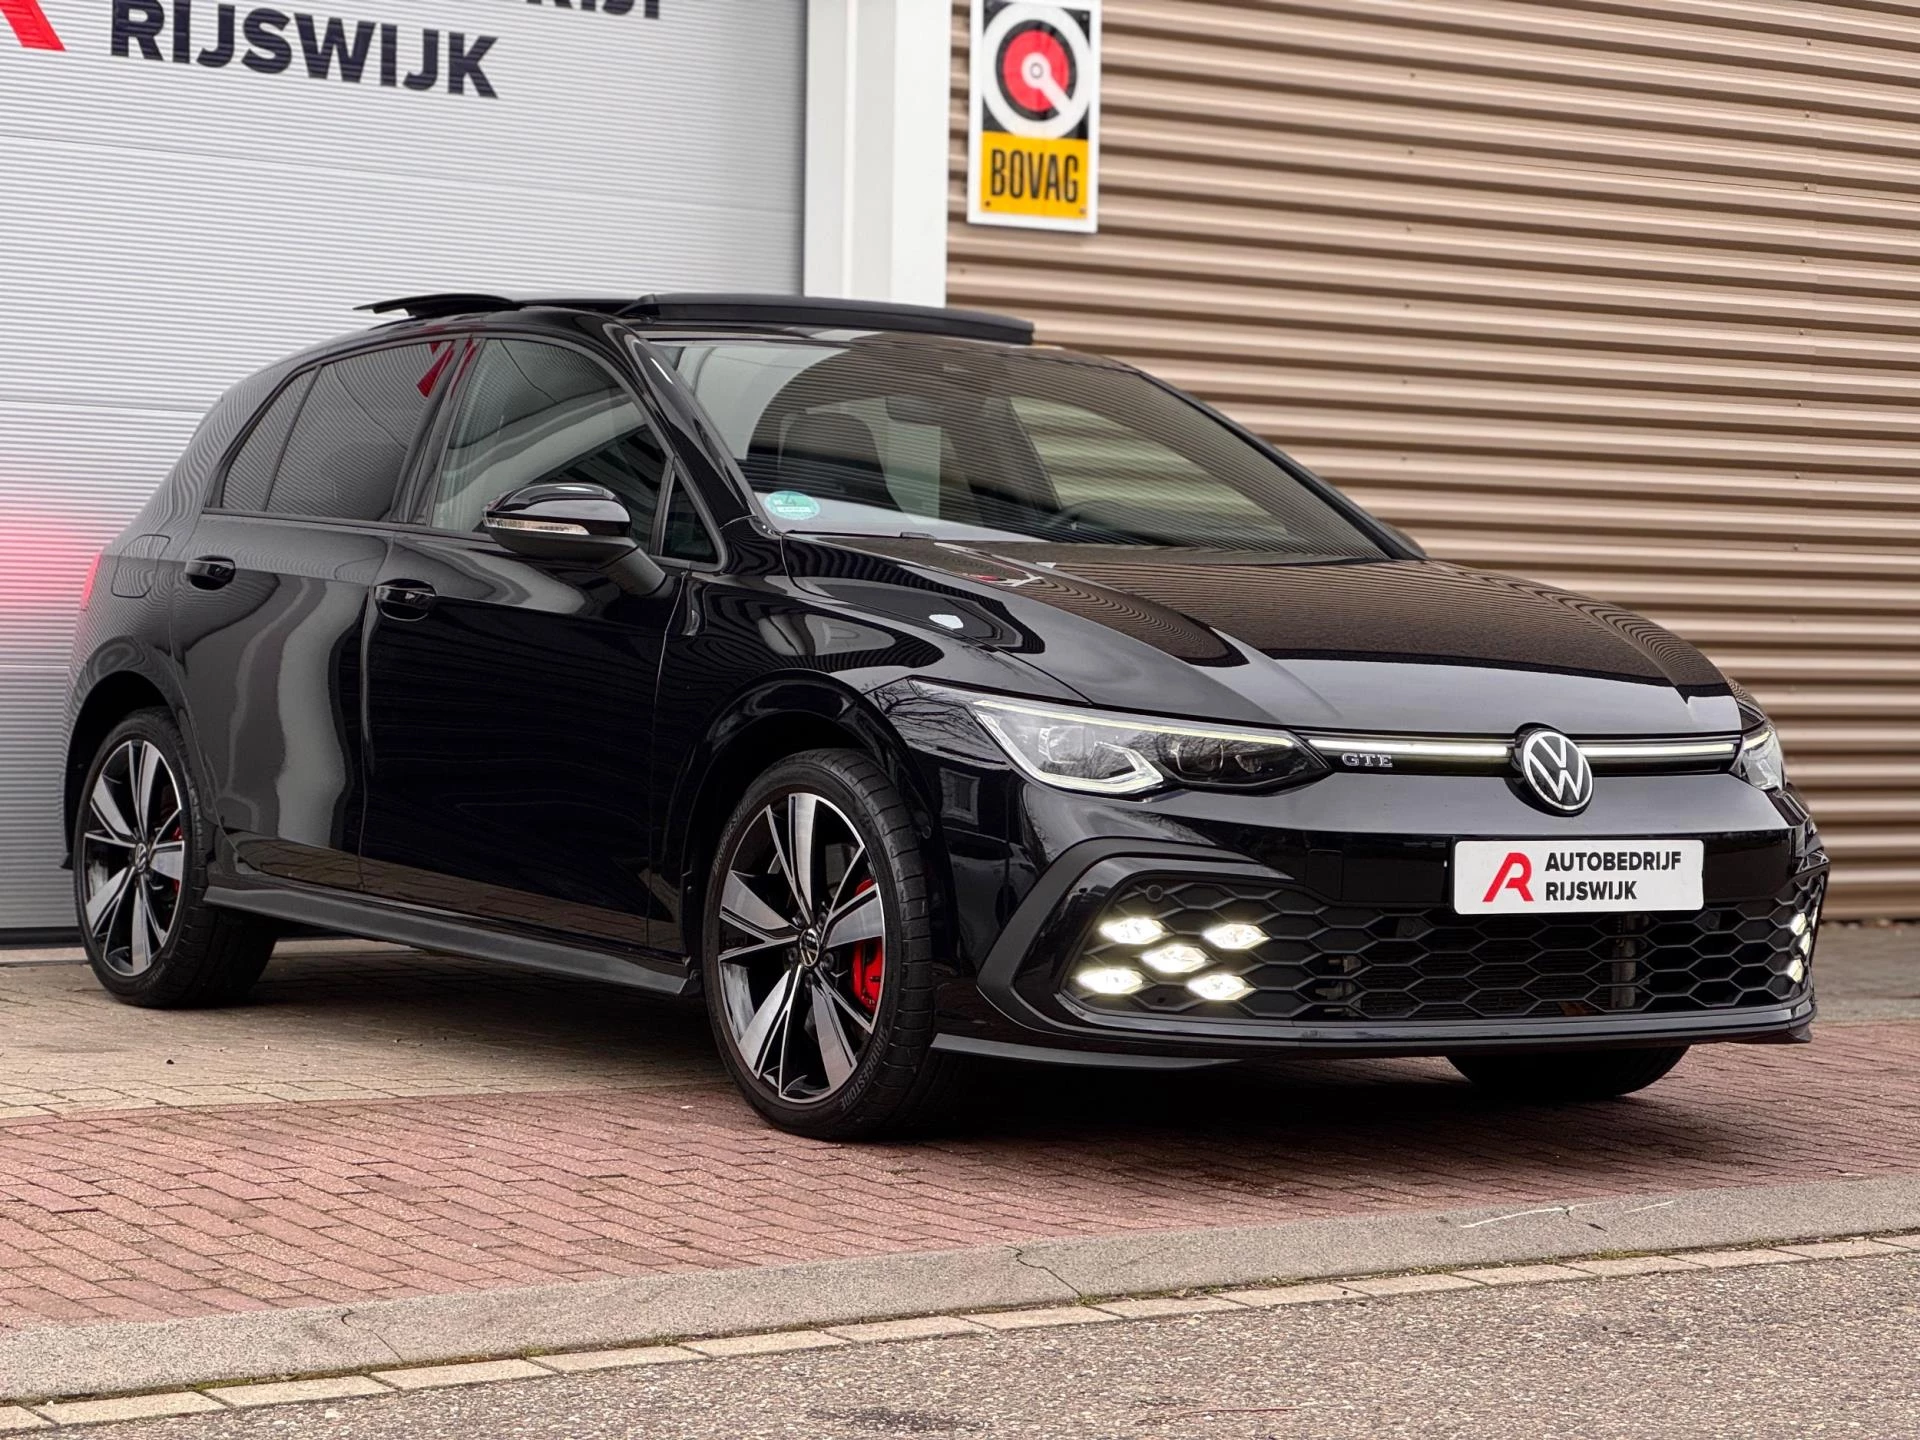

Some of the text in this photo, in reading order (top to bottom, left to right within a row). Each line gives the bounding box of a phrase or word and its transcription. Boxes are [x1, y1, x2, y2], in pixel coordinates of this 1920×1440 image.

[111, 0, 499, 99] RIJSWIJK
[991, 149, 1079, 203] BOVAG
[1342, 752, 1393, 768] GTE
[1545, 851, 1682, 872] AUTOBEDRIJF
[1545, 880, 1637, 901] RIJSWIJK
